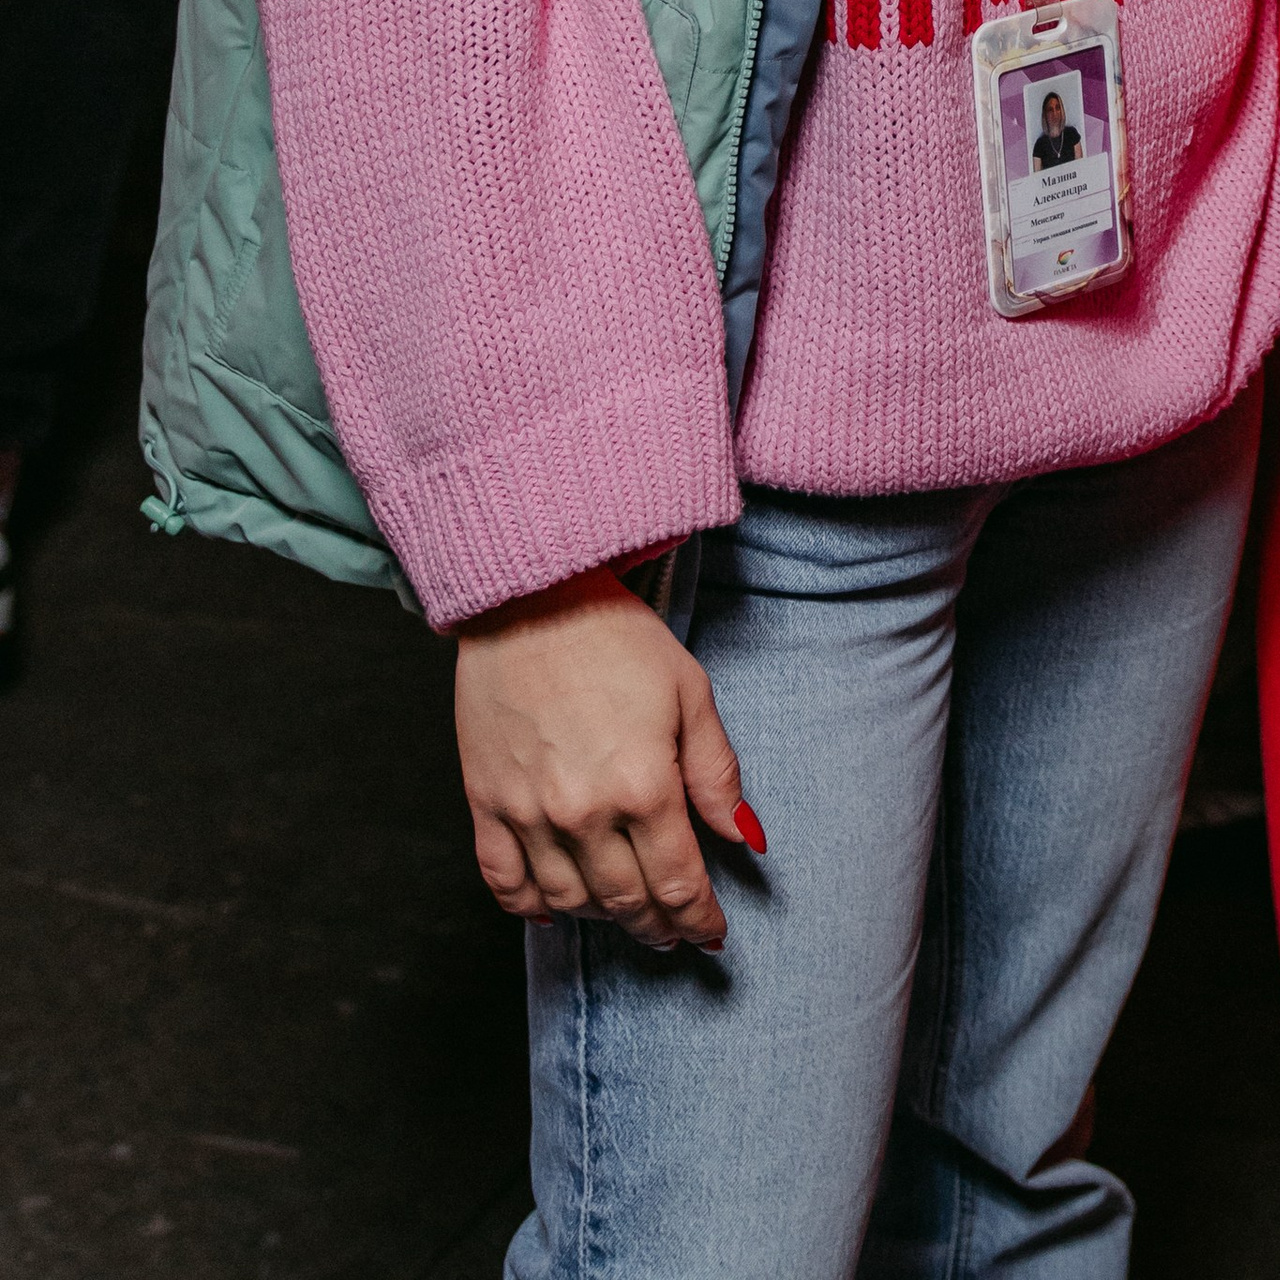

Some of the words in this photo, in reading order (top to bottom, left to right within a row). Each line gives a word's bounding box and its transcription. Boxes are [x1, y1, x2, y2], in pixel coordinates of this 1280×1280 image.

[1041, 171, 1077, 188] Мазина
[1033, 183, 1088, 207] Александра
[1030, 211, 1065, 228] Менеджер
